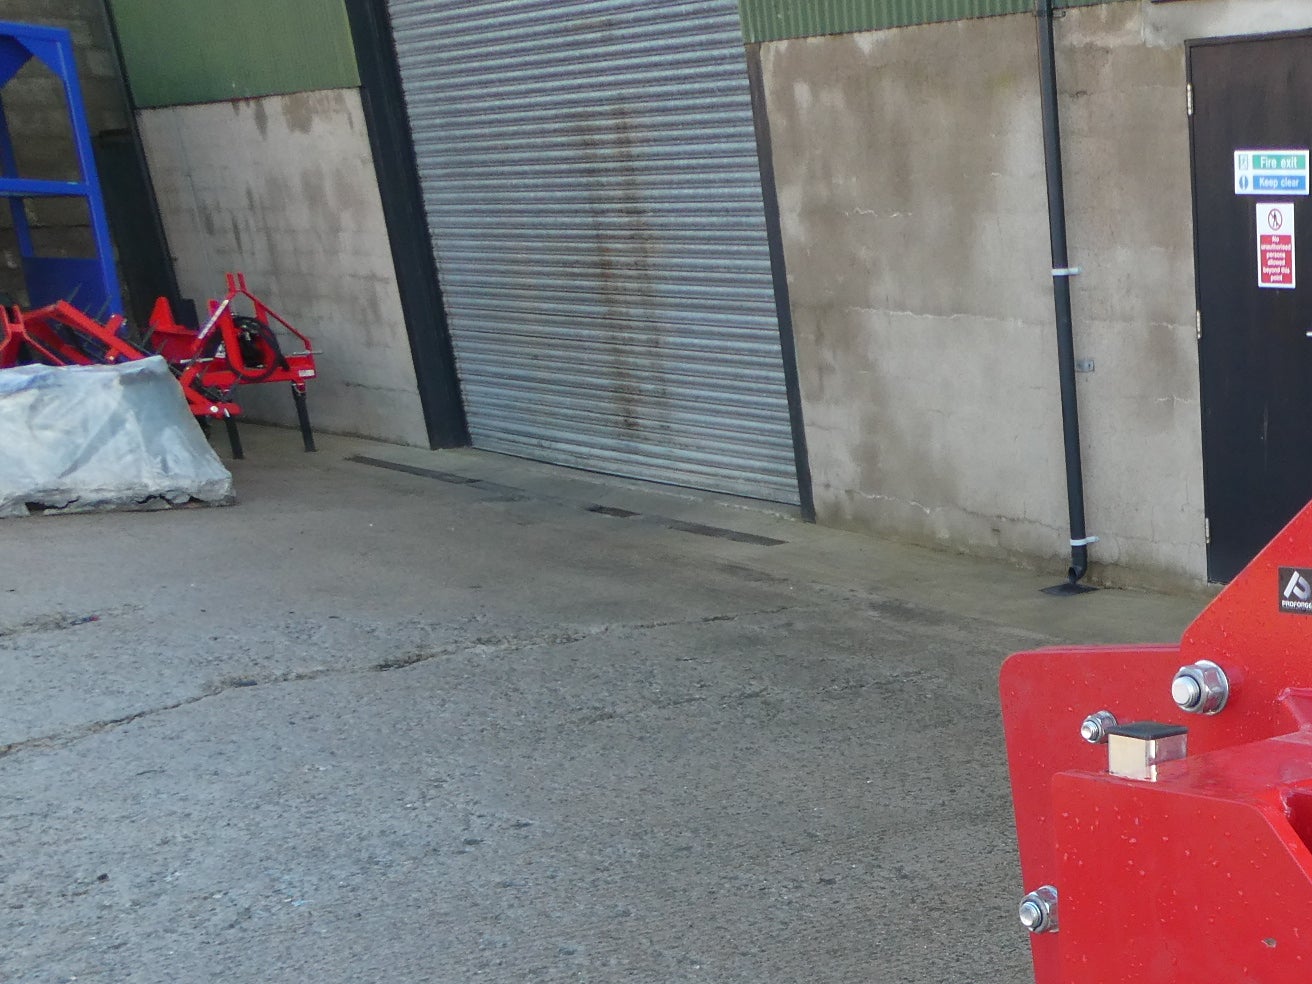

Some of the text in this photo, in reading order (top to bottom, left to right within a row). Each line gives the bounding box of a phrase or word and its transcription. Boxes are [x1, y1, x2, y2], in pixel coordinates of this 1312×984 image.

[1260, 156, 1298, 168] Fire exit
[1259, 176, 1299, 190] Keep clear
[1281, 599, 1312, 610] PROFORGE
